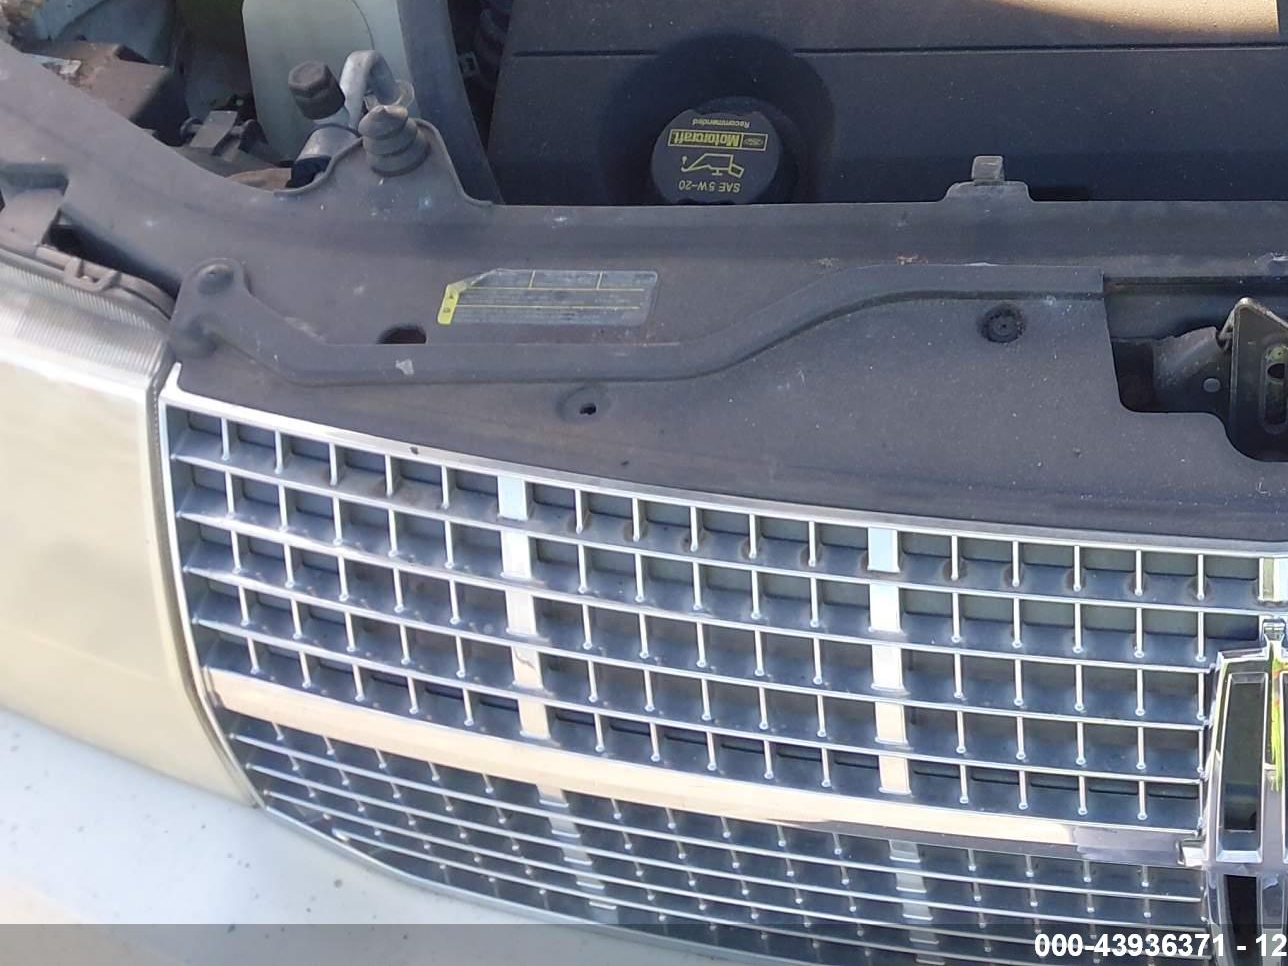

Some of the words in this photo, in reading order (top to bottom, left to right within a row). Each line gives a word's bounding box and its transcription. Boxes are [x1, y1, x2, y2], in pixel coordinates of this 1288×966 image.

[692, 117, 750, 128] Recommended
[673, 131, 741, 147] Motorcraft
[678, 179, 716, 192] 5W-20
[719, 181, 741, 193] SAE
